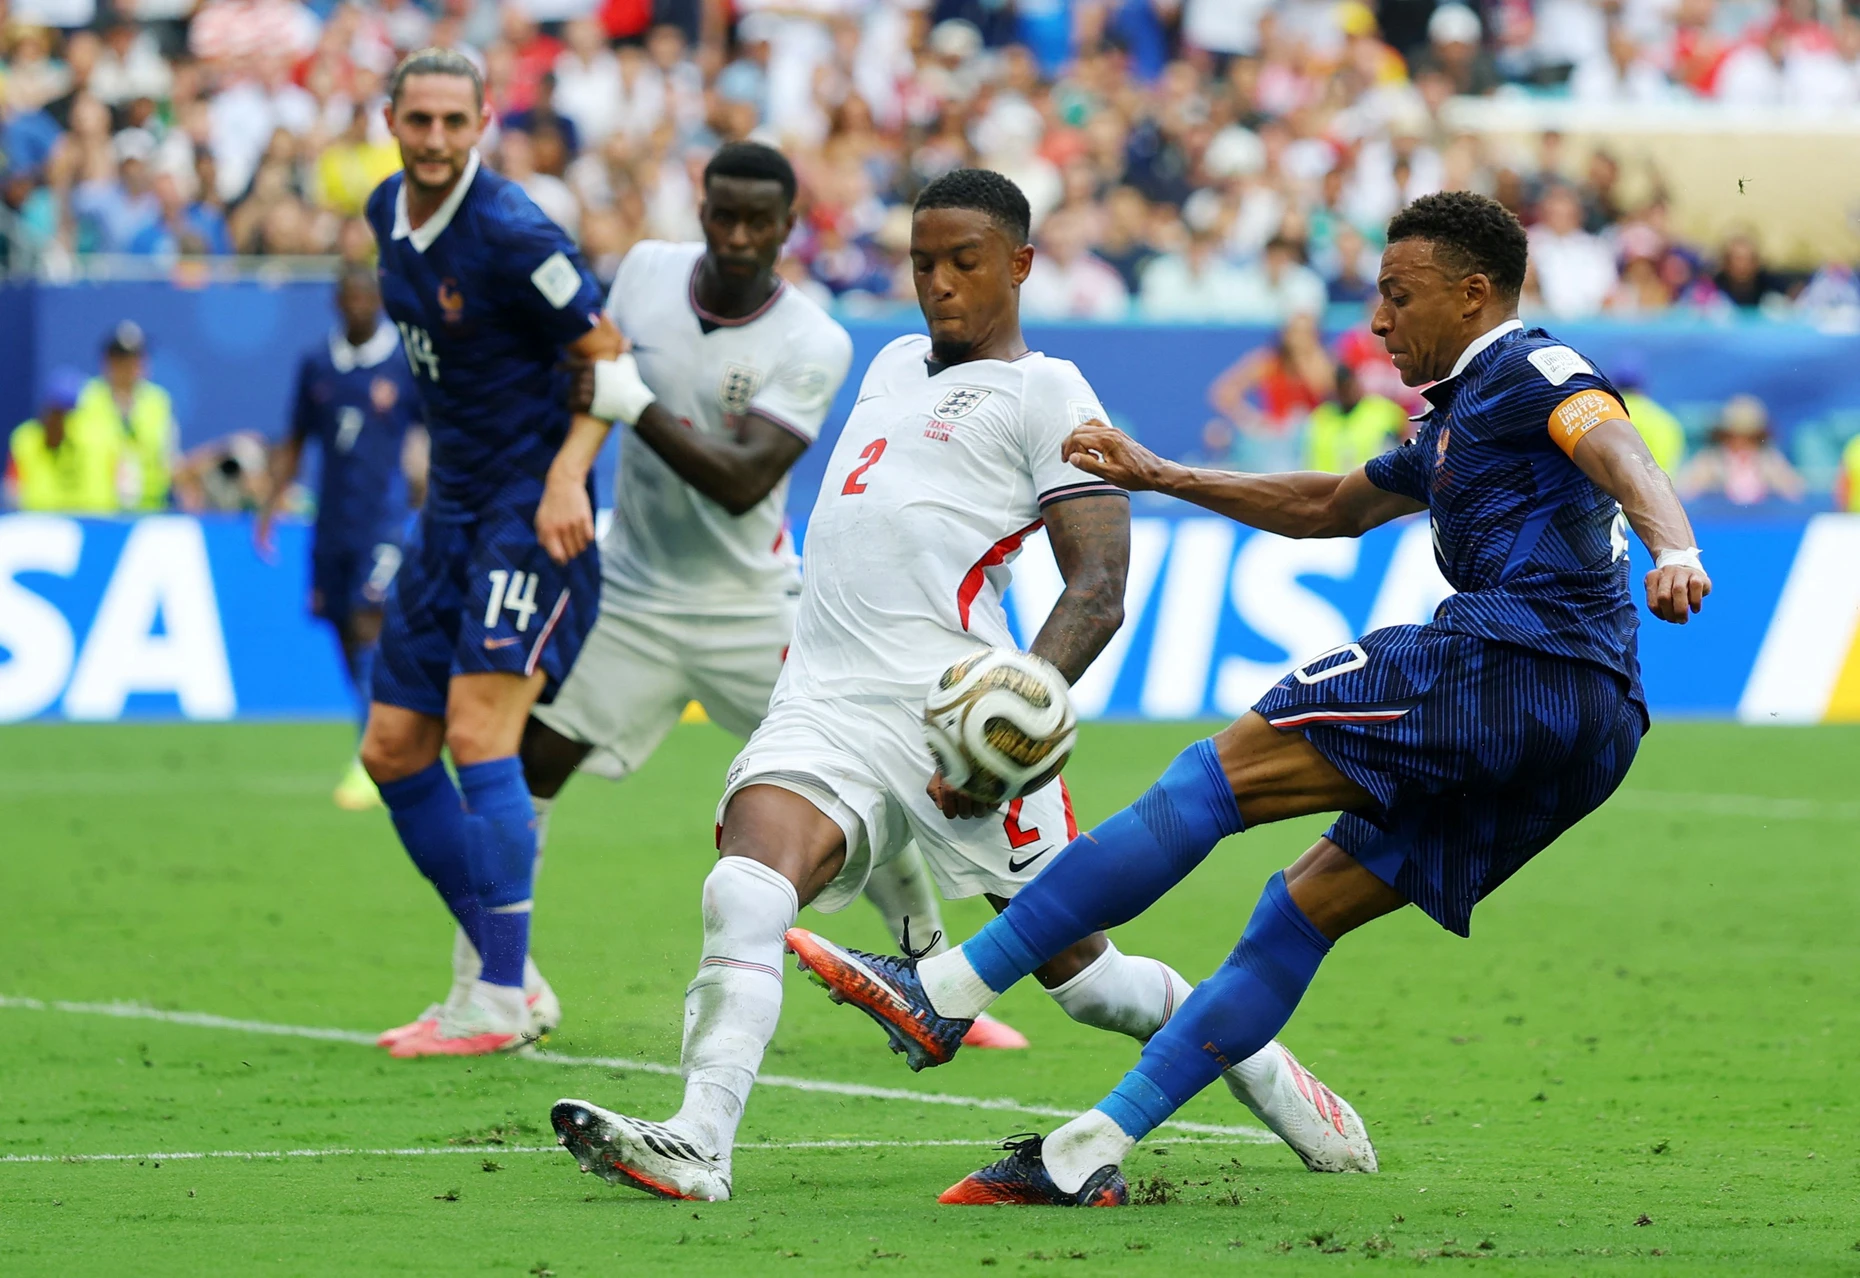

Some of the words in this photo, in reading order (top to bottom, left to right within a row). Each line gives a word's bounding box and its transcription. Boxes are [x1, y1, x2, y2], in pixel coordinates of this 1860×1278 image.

[399, 320, 441, 383] 14
[1557, 393, 1599, 418] FOOTBALL
[1561, 396, 1605, 427] UNITES
[1565, 420, 1581, 436] the
[1580, 403, 1611, 423] World
[926, 420, 956, 432] FRANCE
[1582, 418, 1600, 431] FIFA
[841, 437, 888, 496] 2
[484, 569, 540, 632] 14
